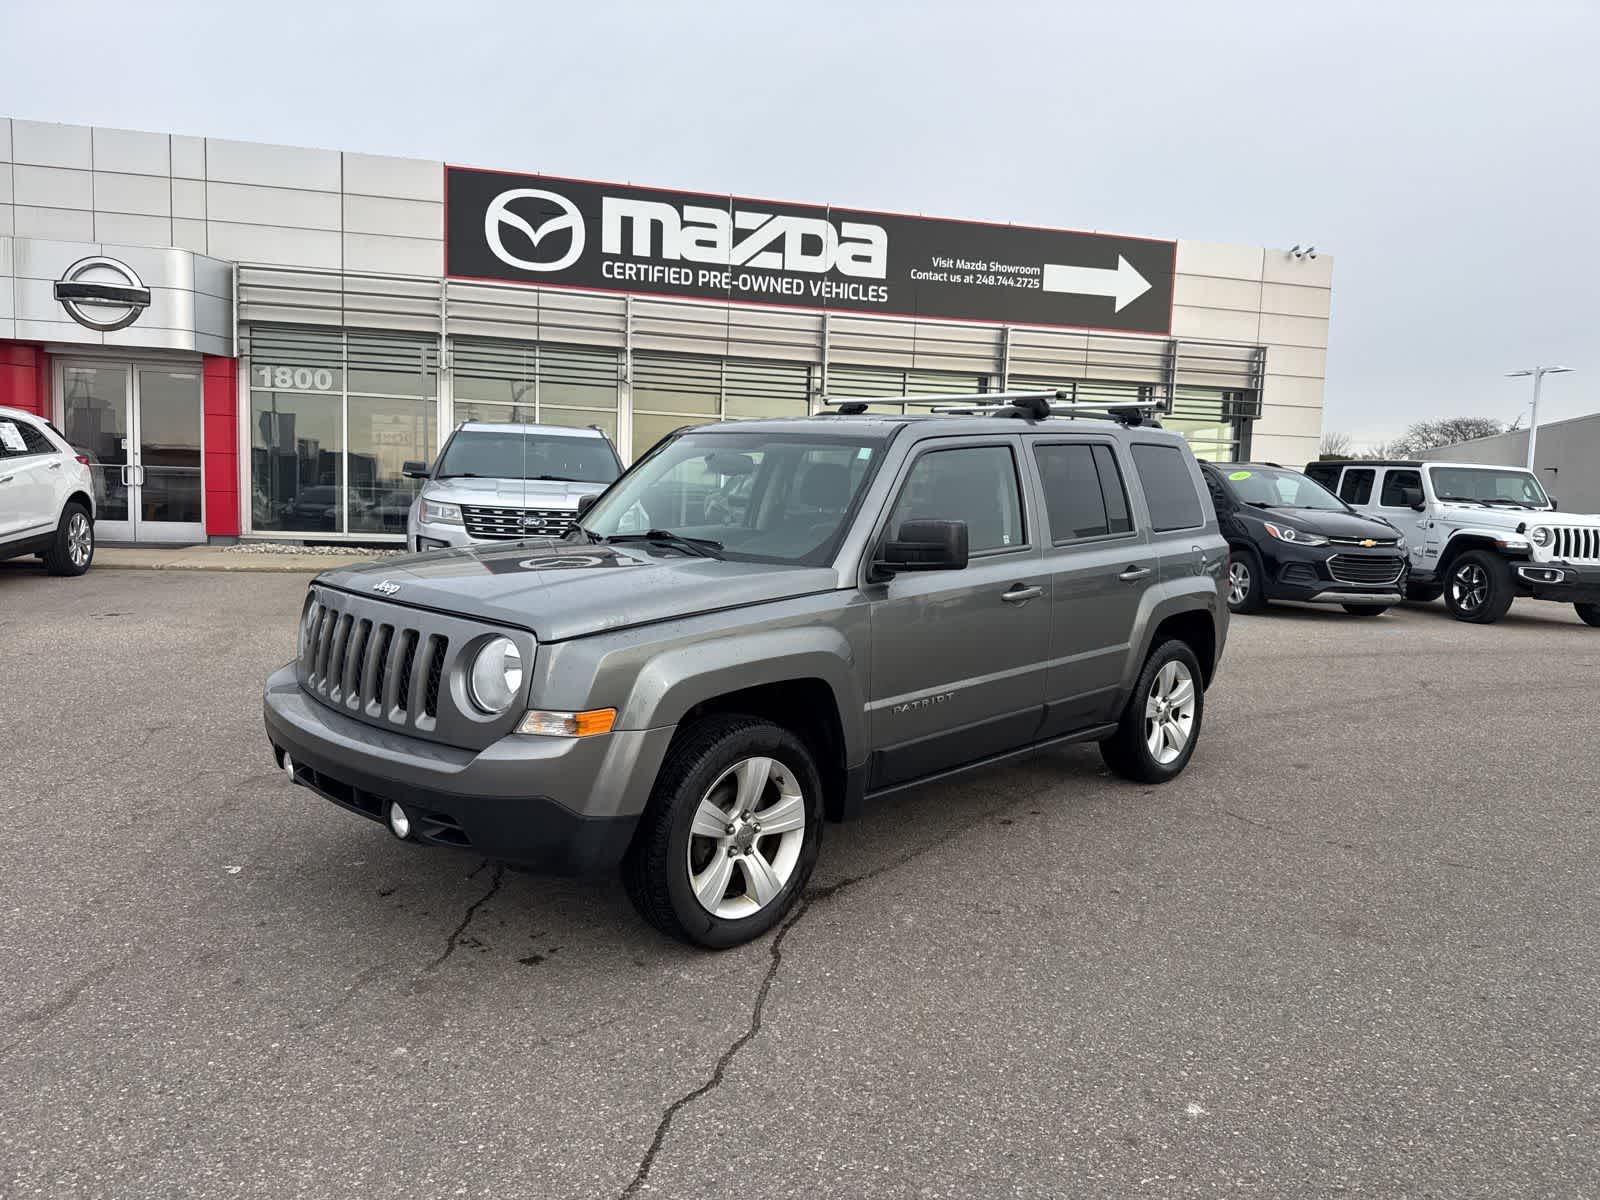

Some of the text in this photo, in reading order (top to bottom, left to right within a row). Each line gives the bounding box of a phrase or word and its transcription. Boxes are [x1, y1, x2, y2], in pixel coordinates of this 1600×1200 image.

[932, 256, 1040, 275] Visit Mazda Showroom
[602, 261, 889, 302] CERTIFIED PRE-OWNED VEHICLES
[911, 269, 1040, 289] Contact us at 248.744.2725
[259, 366, 333, 390] 1800
[373, 580, 401, 595] Jeep
[893, 692, 954, 713] PATRIOT
